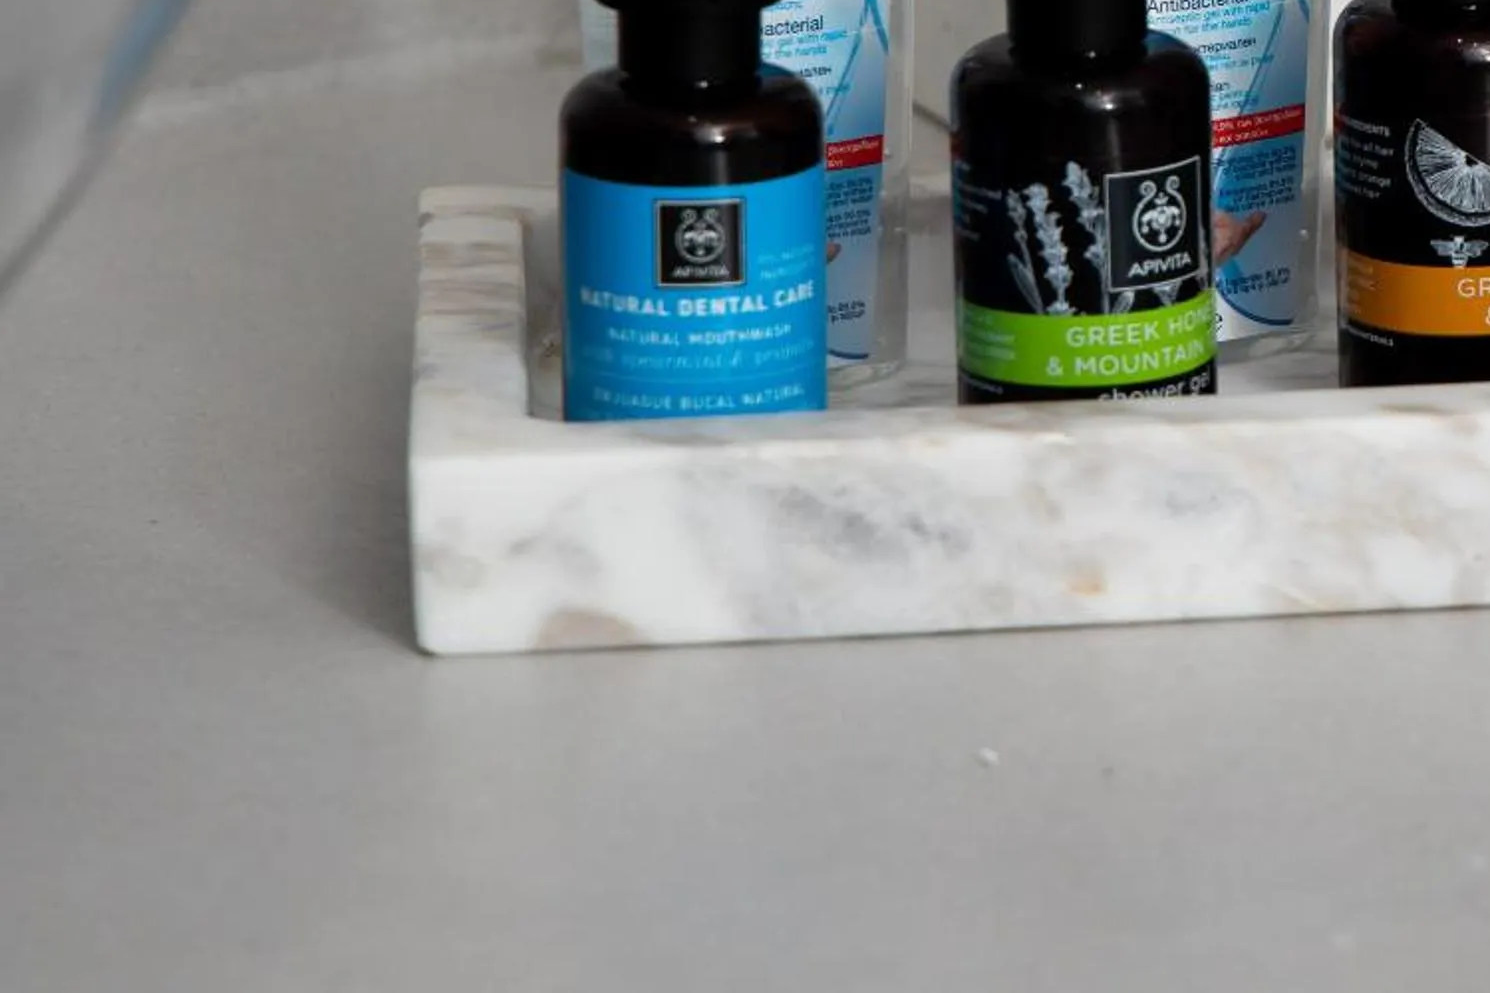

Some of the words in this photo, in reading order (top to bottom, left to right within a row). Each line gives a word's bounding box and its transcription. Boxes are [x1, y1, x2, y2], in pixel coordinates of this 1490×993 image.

[761, 14, 824, 37] acterial
[1128, 251, 1193, 278] APIVITA
[580, 285, 670, 317] NATURAL
[677, 293, 769, 318] DENTAL
[773, 278, 816, 307] CARE
[608, 326, 681, 346] NATURAL
[688, 321, 792, 345] MOUTHWASH
[1066, 320, 1161, 347] GREEK
[1045, 357, 1064, 376] &
[1074, 338, 1206, 376] MOUNTAIN
